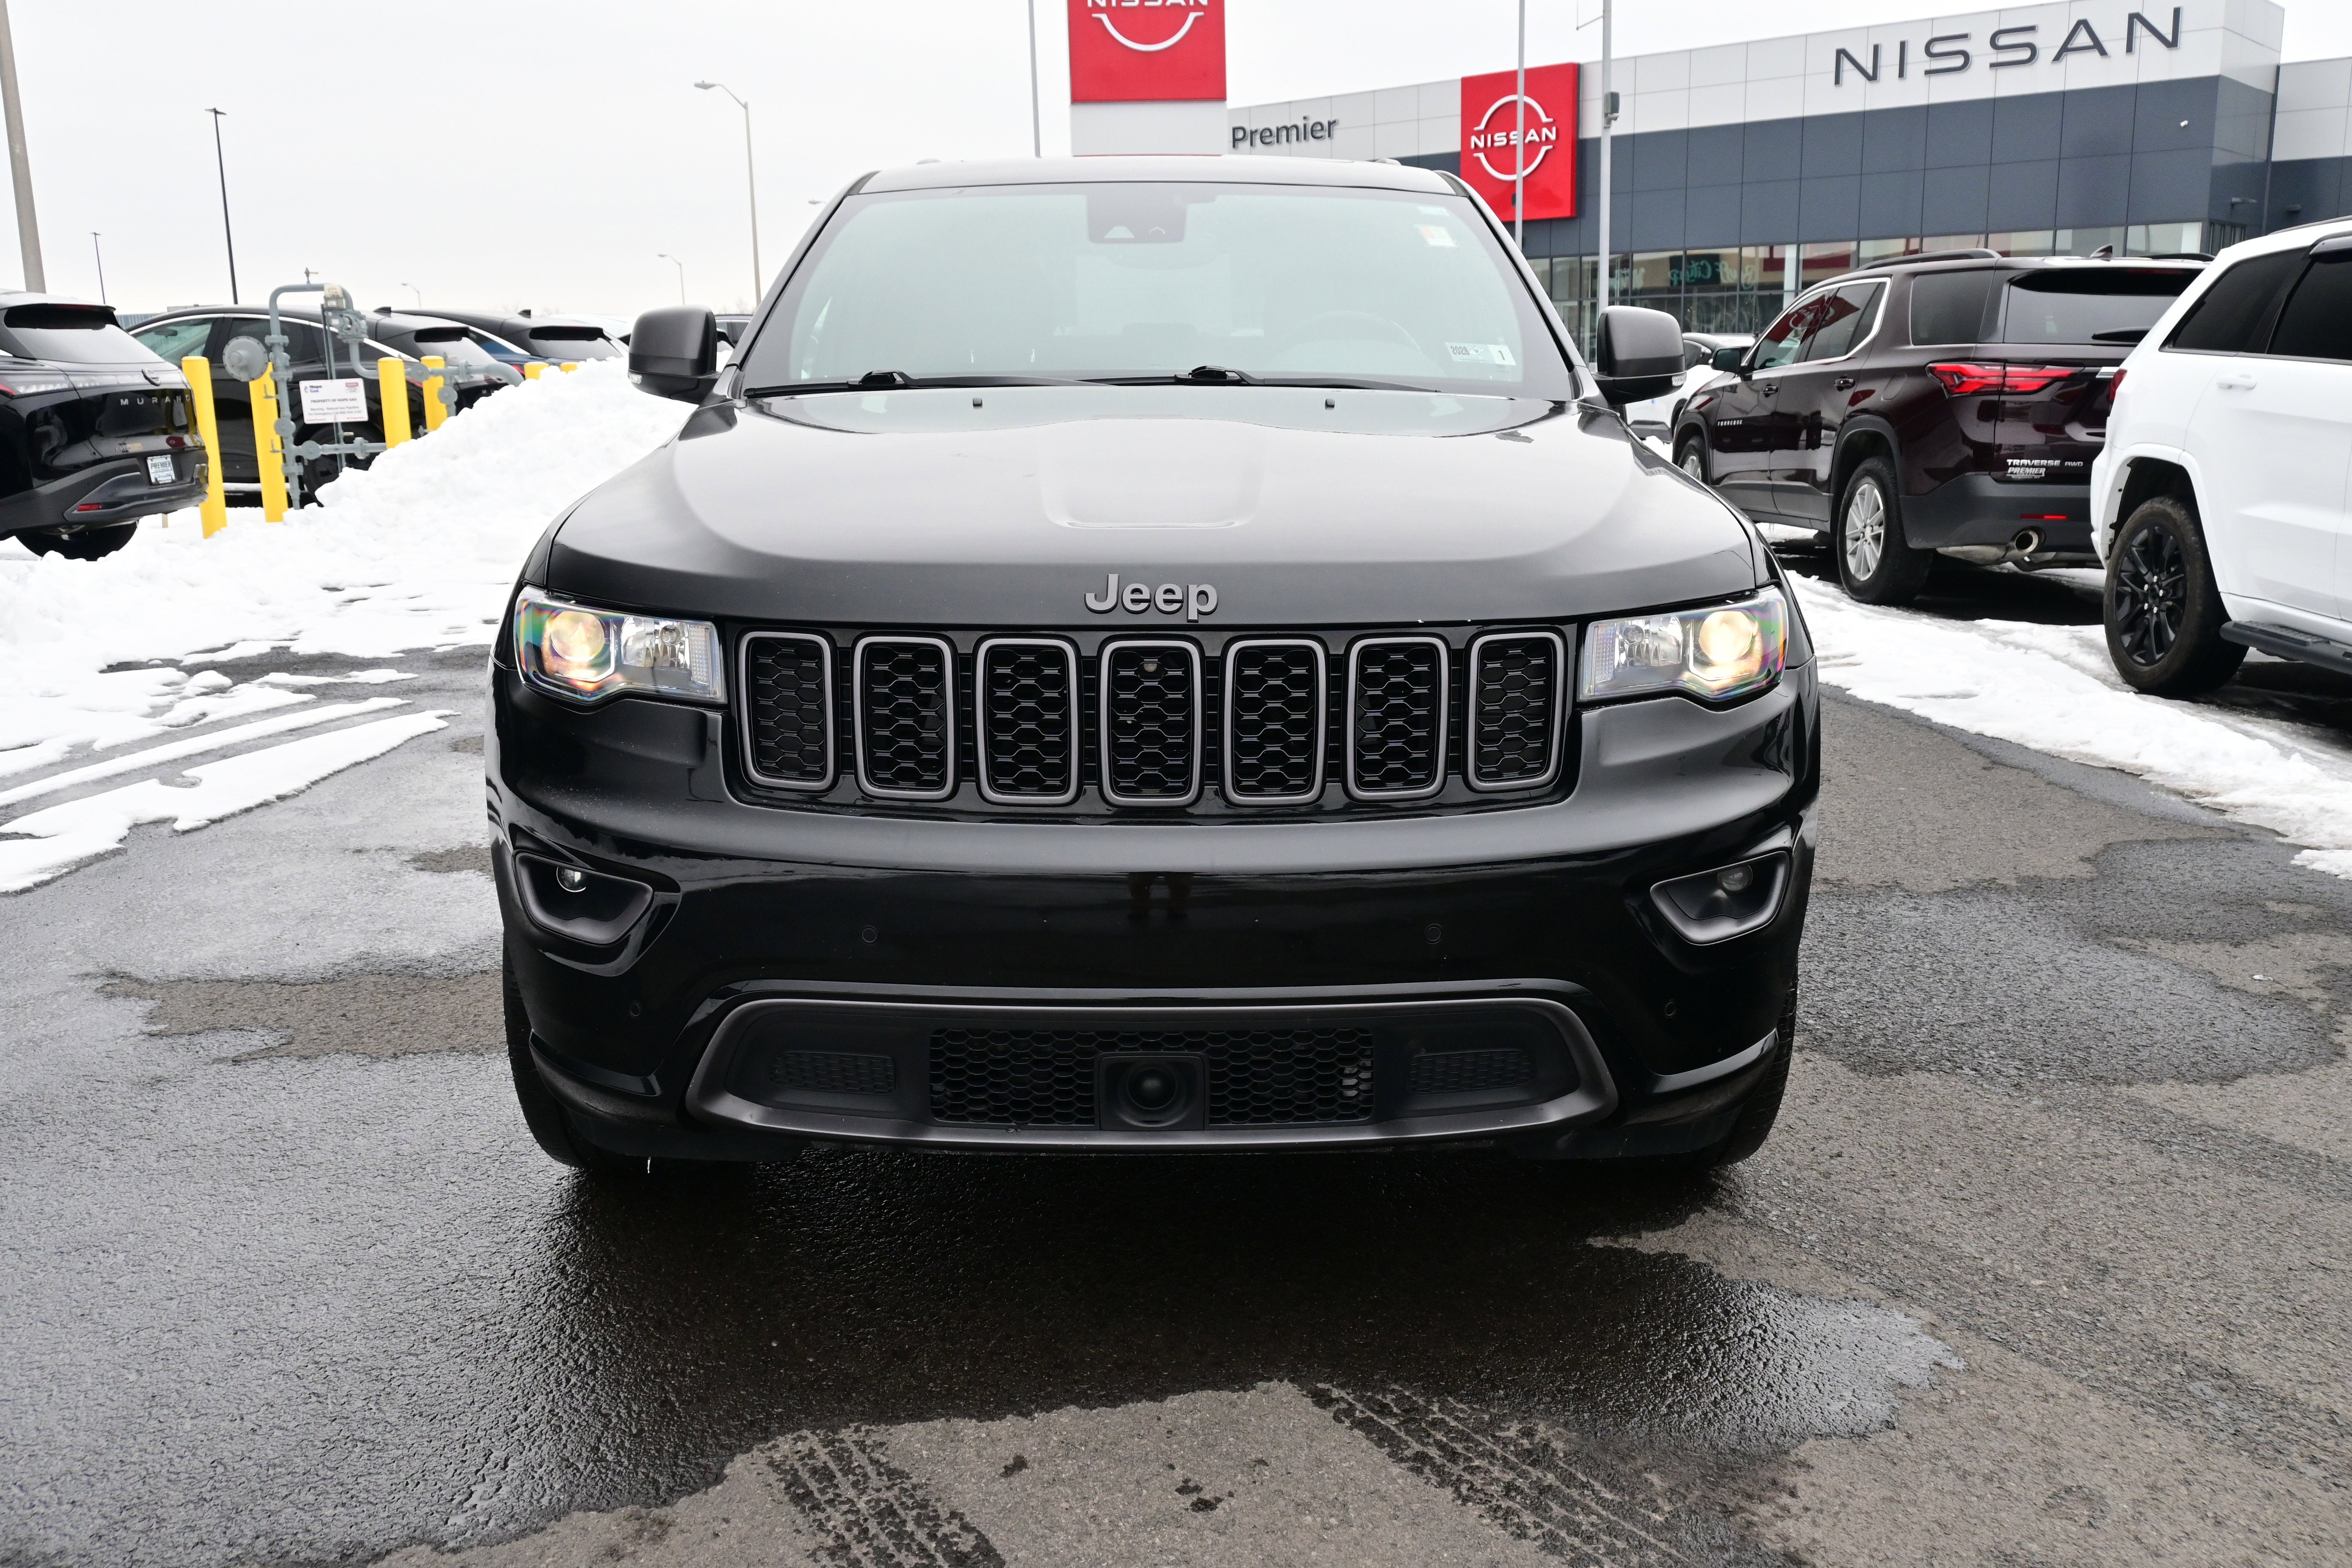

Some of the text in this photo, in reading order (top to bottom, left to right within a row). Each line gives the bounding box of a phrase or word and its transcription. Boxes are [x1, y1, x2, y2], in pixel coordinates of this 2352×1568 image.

[1835, 6, 2182, 86] NISSAN
[1232, 115, 1339, 149] Premier
[1470, 126, 1556, 149] NISSAN
[1450, 346, 1470, 355] 2028
[120, 394, 190, 406] MURANO
[150, 460, 172, 470] PREMIER
[2007, 467, 2046, 476] PREMIER
[1084, 574, 1218, 623] Jeep
